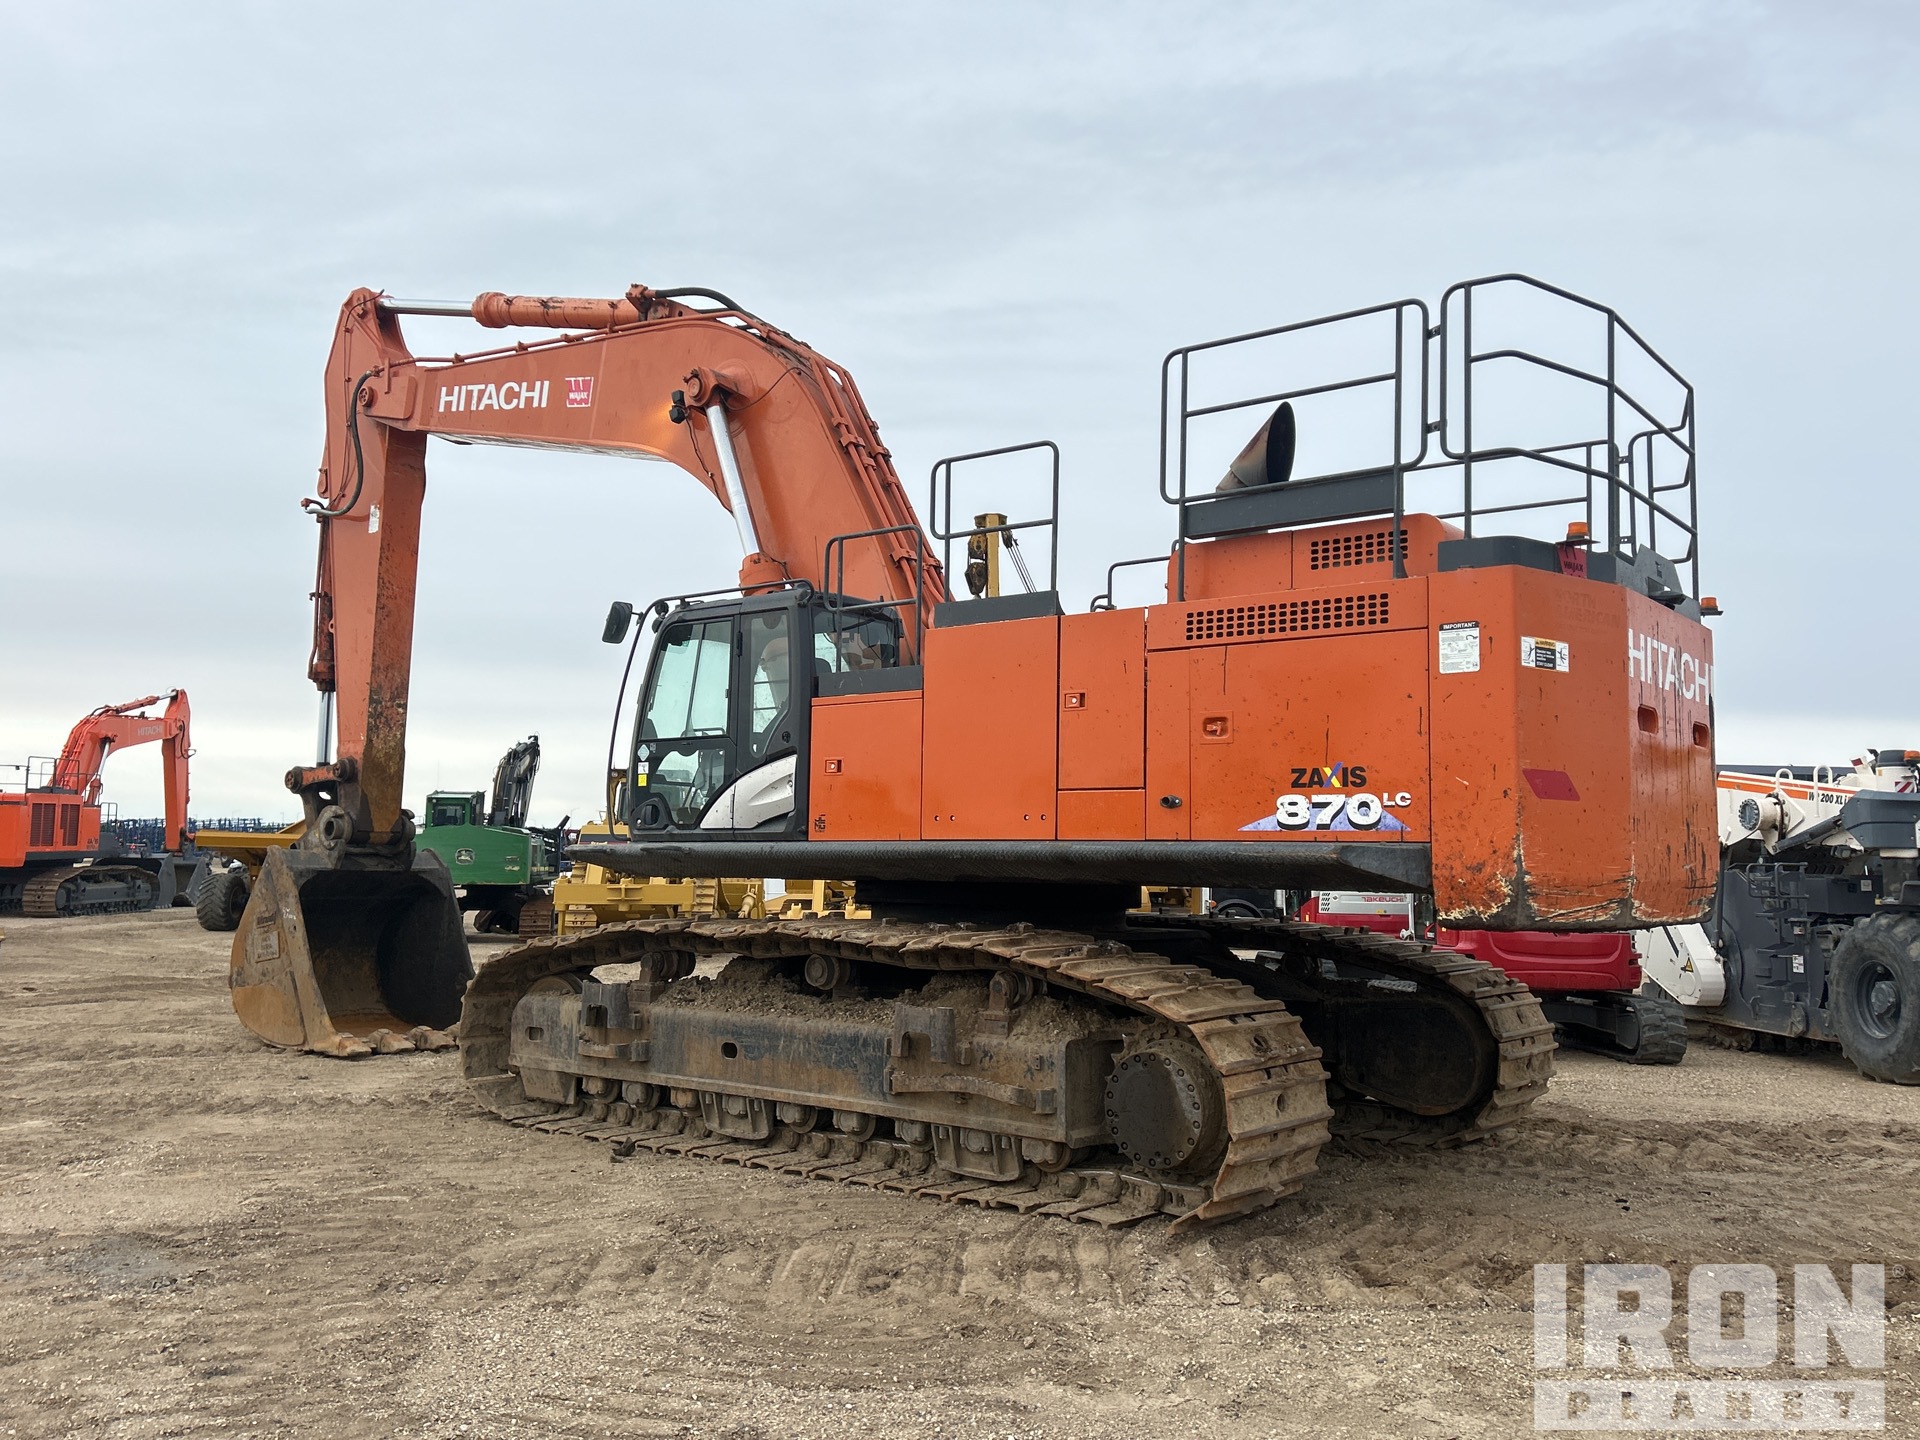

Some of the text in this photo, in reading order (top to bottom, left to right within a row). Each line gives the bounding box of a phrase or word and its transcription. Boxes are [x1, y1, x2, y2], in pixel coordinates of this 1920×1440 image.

[438, 380, 550, 412] HITACHI
[569, 391, 588, 401] WAJAX
[1563, 560, 1584, 573] WAJAX
[1628, 628, 1714, 706] HITACHI
[1290, 761, 1367, 789] ZAXIS
[1820, 793, 1834, 804] 200
